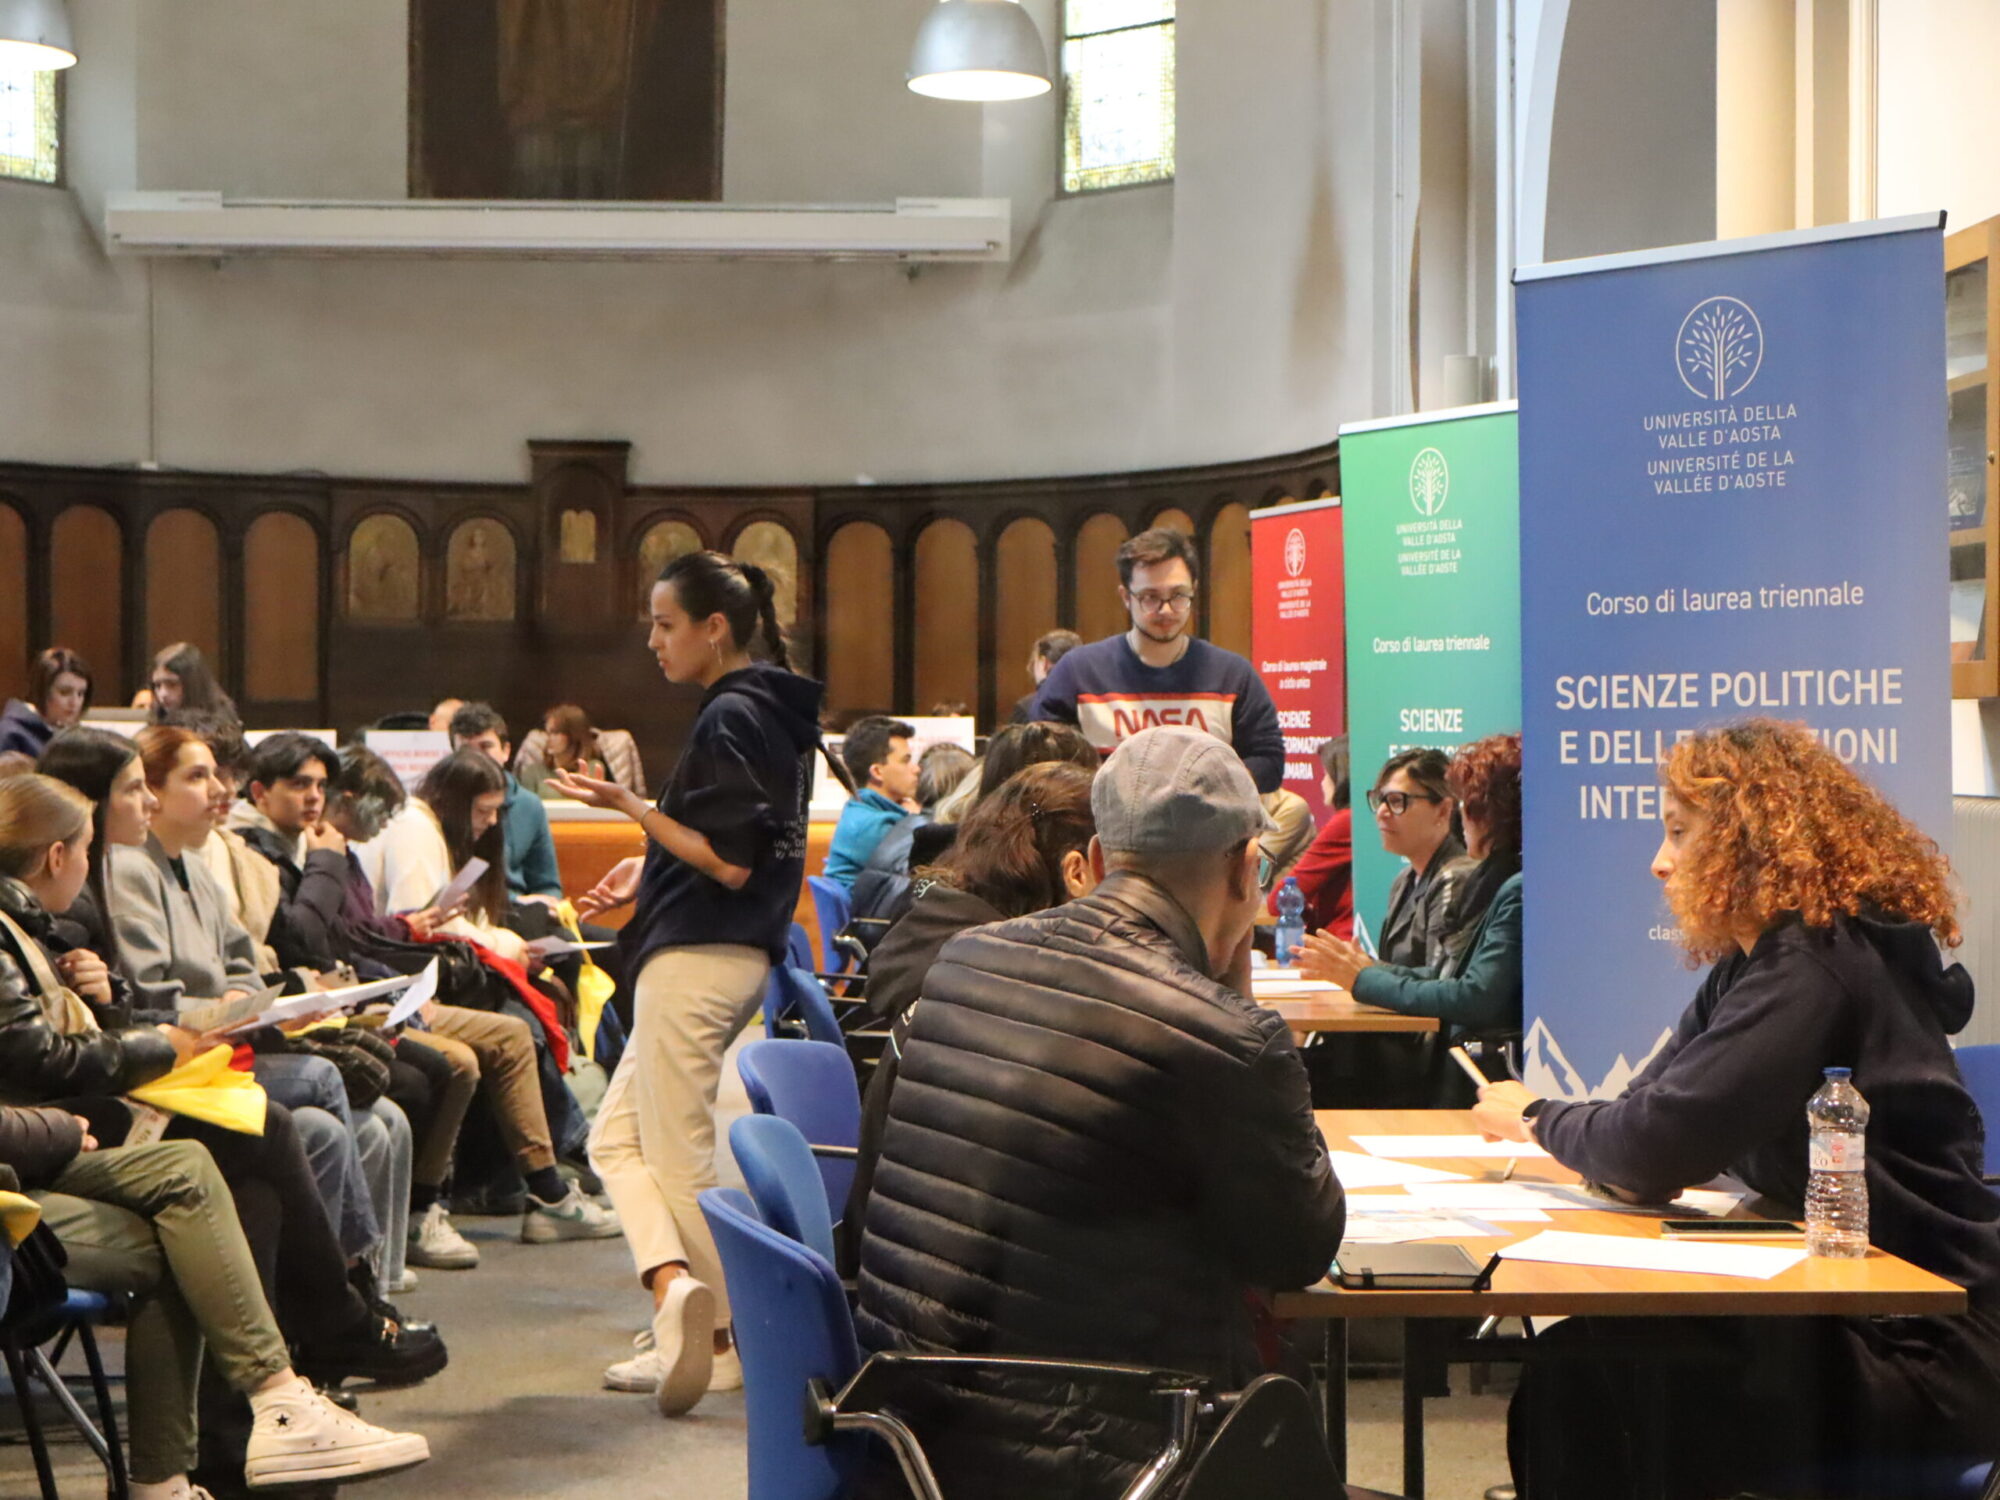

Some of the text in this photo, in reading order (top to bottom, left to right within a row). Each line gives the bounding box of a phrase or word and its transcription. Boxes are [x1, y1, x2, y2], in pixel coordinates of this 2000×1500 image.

[1643, 403, 1798, 431] UNIVERSITÀ DELLA
[1658, 425, 1782, 449] VALLE D'AOSTA
[1647, 450, 1794, 476] UNIVERSITÉ DE LA
[1654, 471, 1787, 495] VALLÉE D'AOSTE
[1440, 518, 1463, 531] DELLA
[1402, 534, 1425, 546] VALLE
[1586, 581, 1865, 616] Corso di laurea triennale
[1373, 634, 1490, 653] Corso di laurea triennale
[1555, 668, 1903, 711] SCIENZE POLITICHE
[1113, 707, 1209, 741] NASA
[1400, 708, 1463, 732] SCIENZE
[1560, 731, 1578, 764] E
